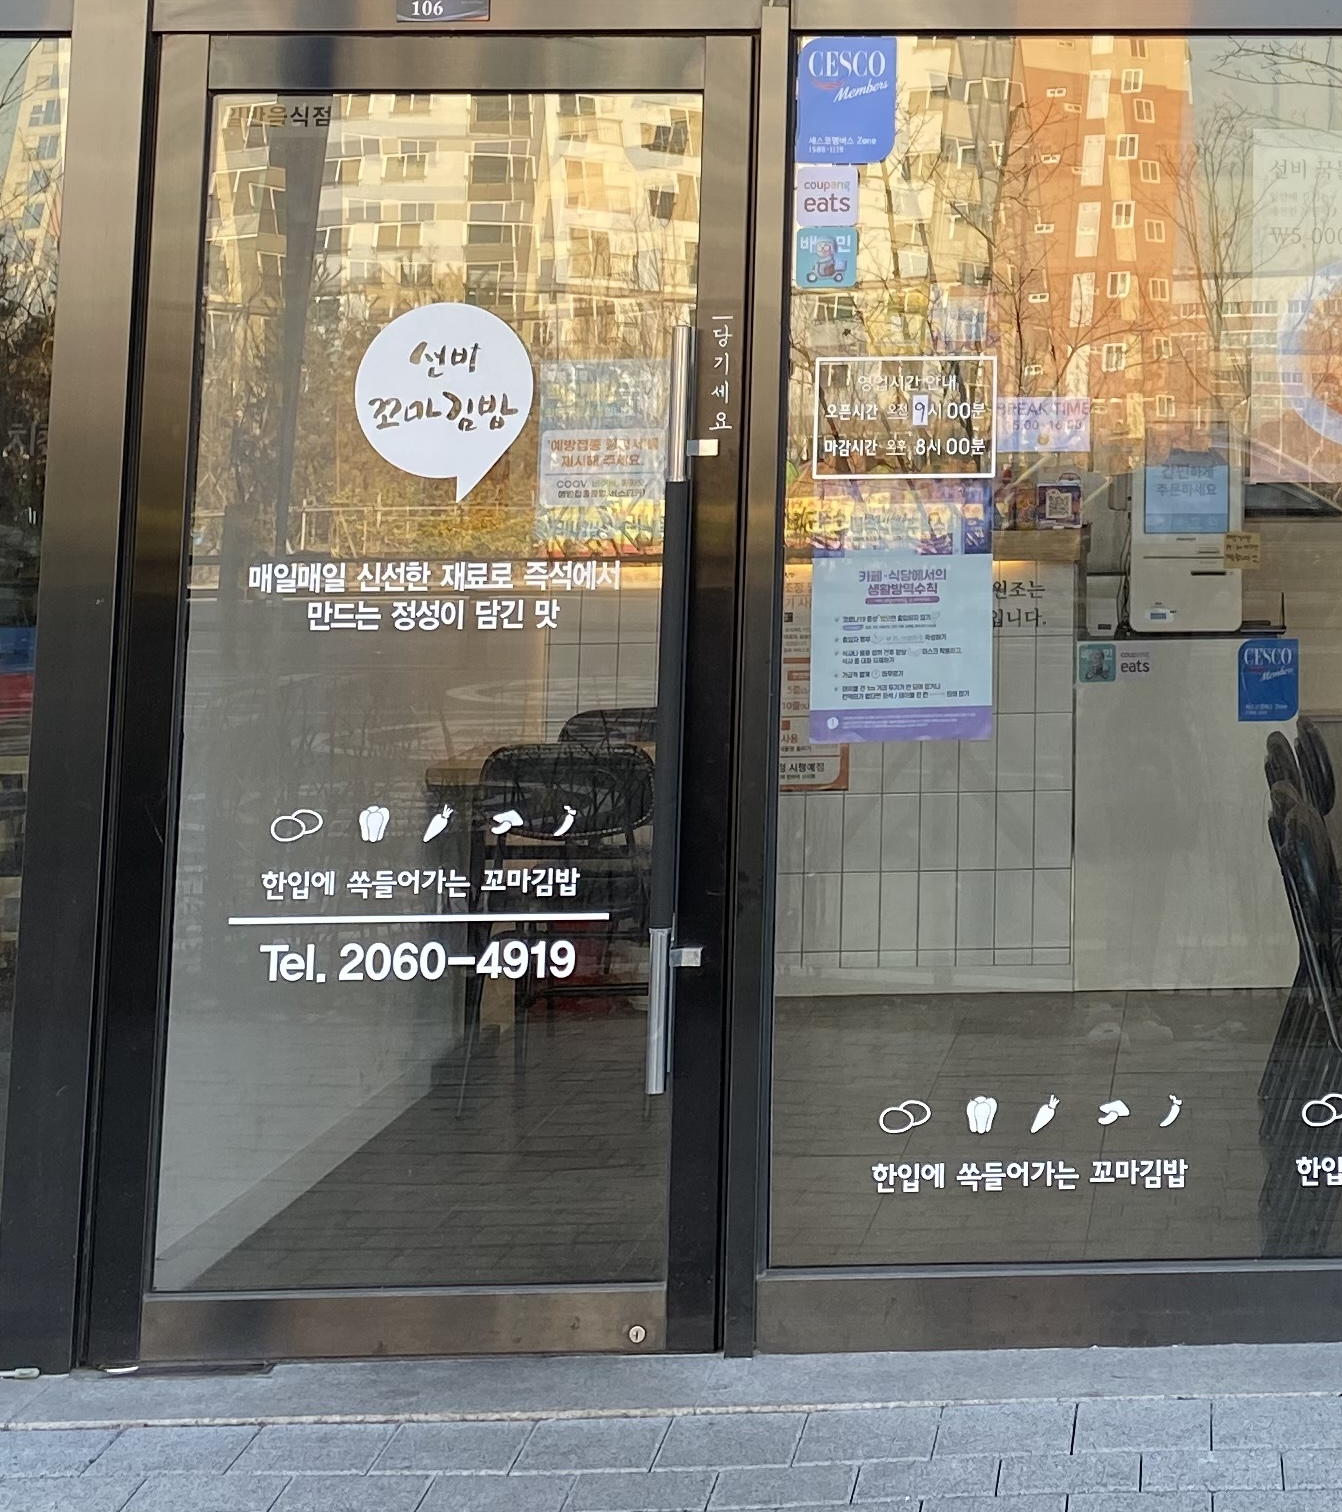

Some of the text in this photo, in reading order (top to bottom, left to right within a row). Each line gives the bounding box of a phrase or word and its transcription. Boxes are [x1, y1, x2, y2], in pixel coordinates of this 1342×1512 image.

[411, 0, 444, 16] 106
[808, 50, 887, 78] CESCO
[832, 77, 889, 104] Members
[1269, 158, 1307, 181] 선비
[803, 193, 851, 213] eats
[408, 340, 480, 379] 선비
[709, 324, 733, 431] 당기세요
[857, 374, 957, 392] 영업시간 안내
[368, 390, 520, 432] 꼬마김밥
[824, 402, 879, 420] 오픈시간
[887, 402, 909, 420] 오전
[824, 439, 878, 457] 마감시간
[886, 438, 907, 456] 오후
[249, 559, 621, 593] 매일매일 신선한 재료로 즉석에서
[306, 599, 560, 631] 만드는 정성이 담긴 맛
[1120, 660, 1150, 673] eats
[1243, 647, 1292, 666] CESCO
[261, 867, 581, 901] 한입에 쏙들어가는 꼬마김밥
[259, 939, 577, 983] Tel. 2060-4919
[871, 1158, 1189, 1194] 한입에 쏙들어가는 꼬마김밥
